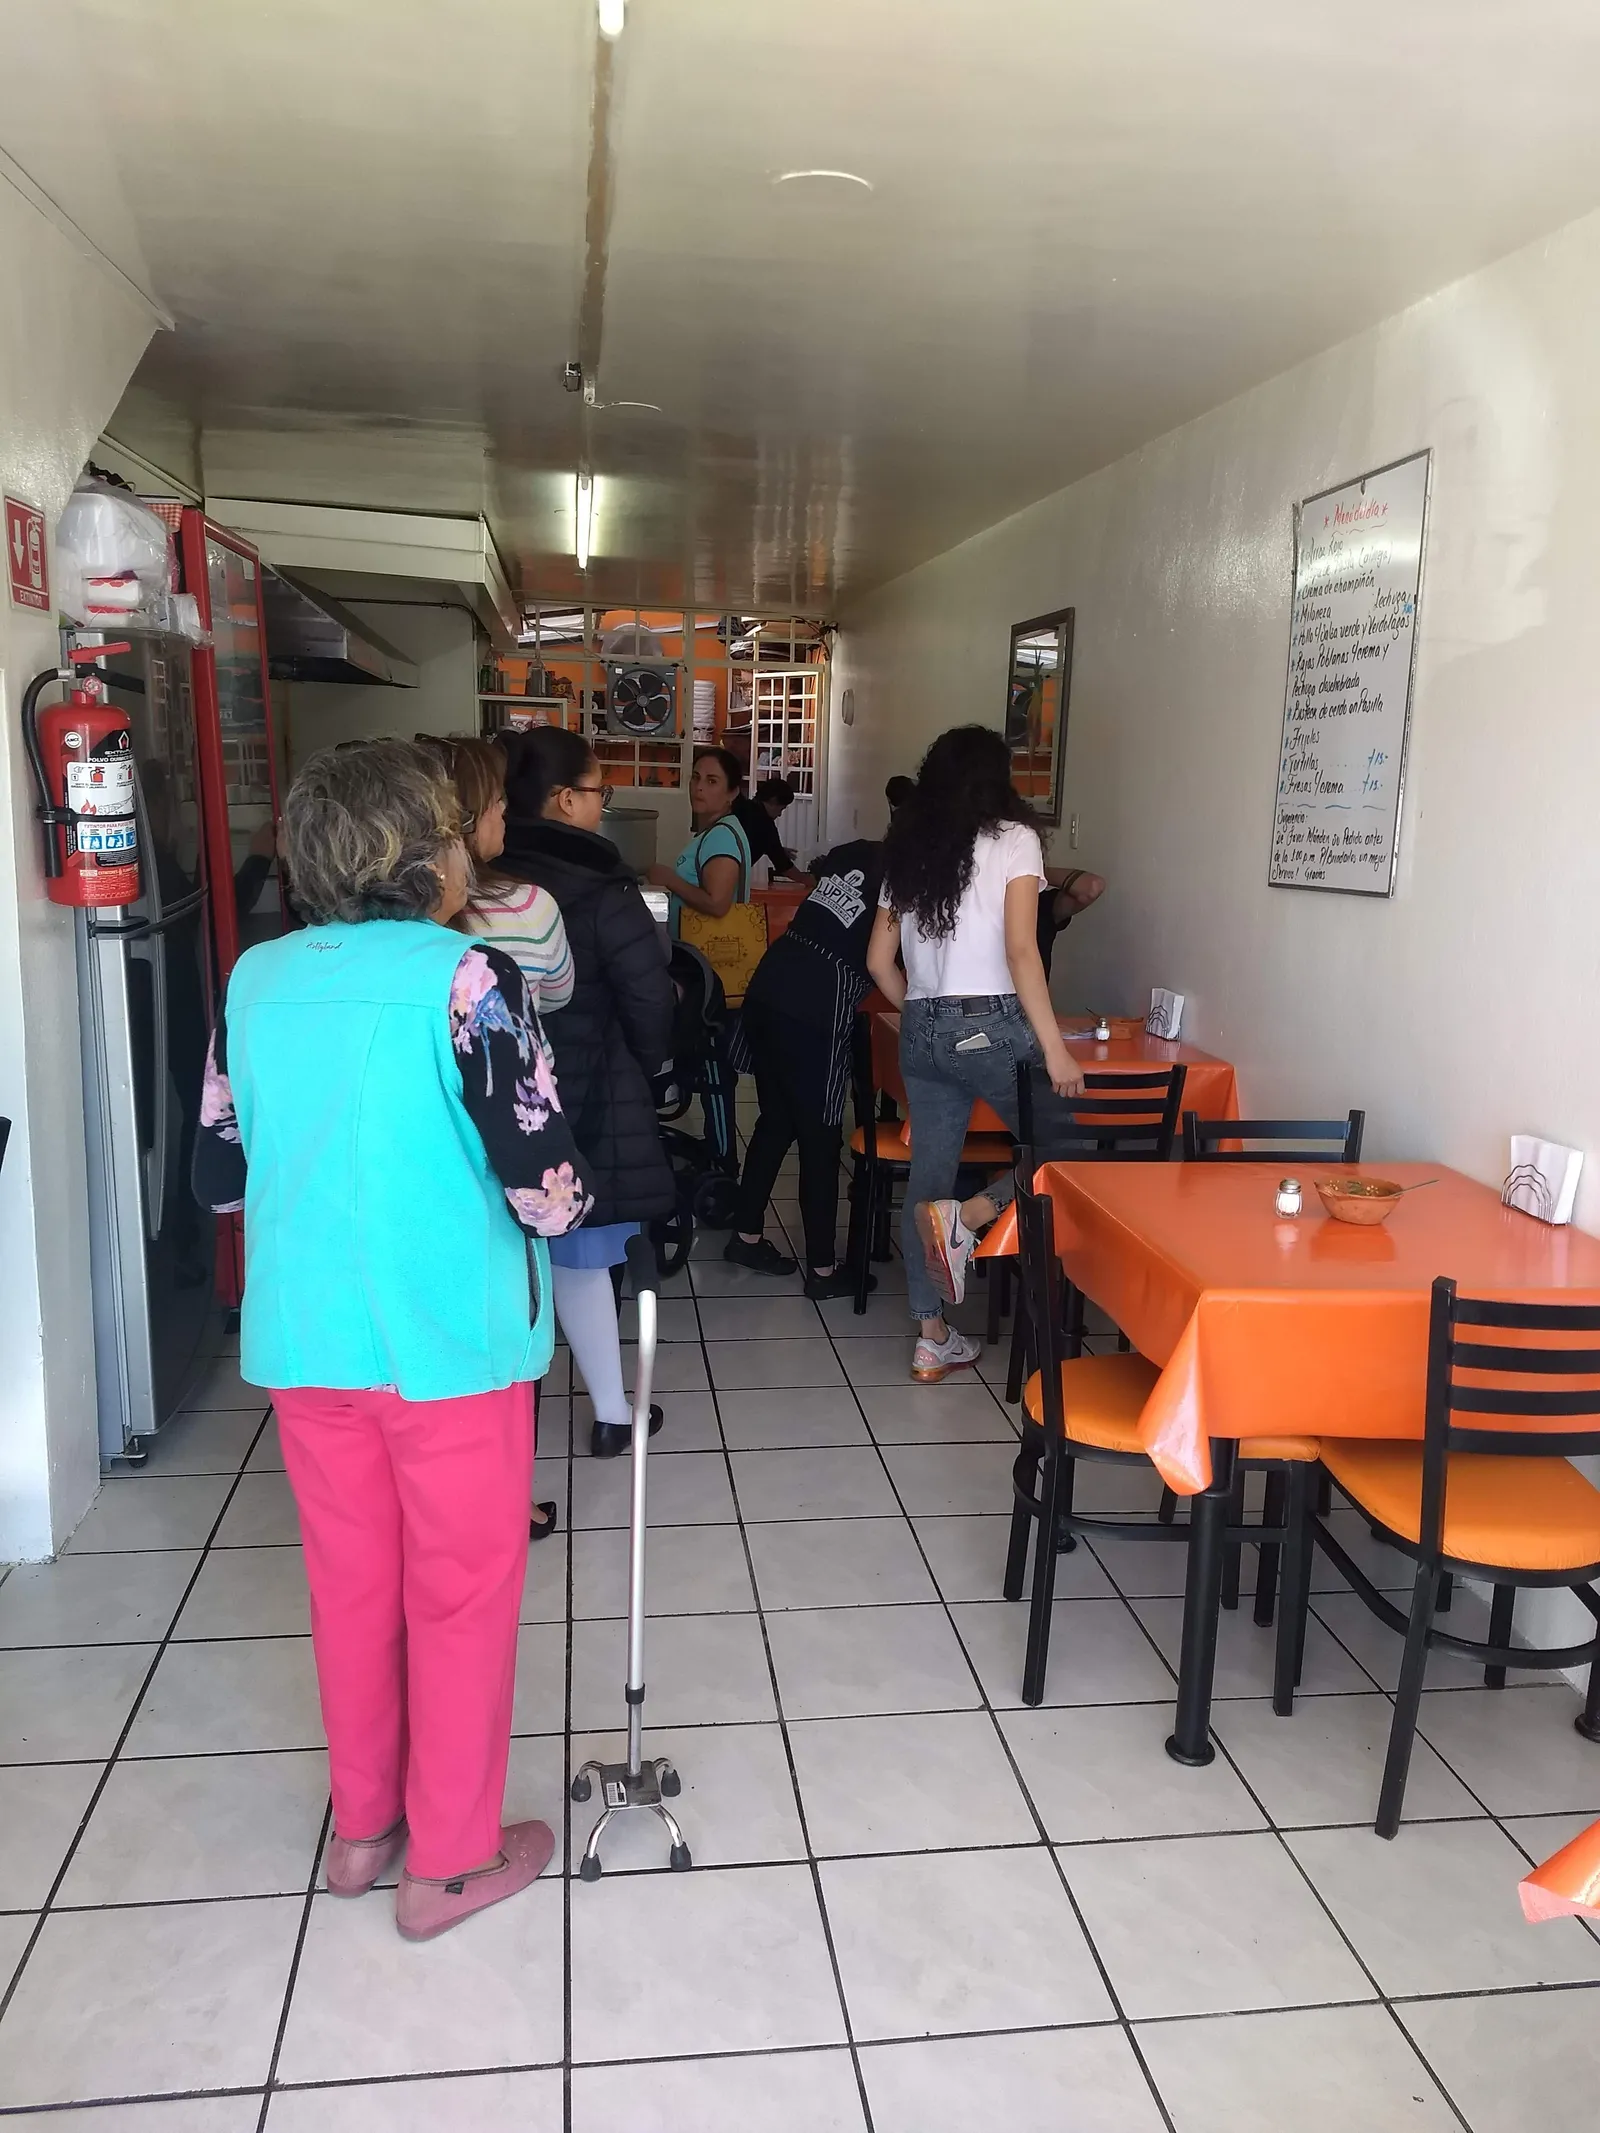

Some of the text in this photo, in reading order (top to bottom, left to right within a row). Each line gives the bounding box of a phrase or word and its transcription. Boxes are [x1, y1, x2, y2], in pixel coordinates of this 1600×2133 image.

[1324, 580, 1332, 595] de
[1340, 619, 1360, 638] verde
[816, 880, 860, 918] LUPITA
